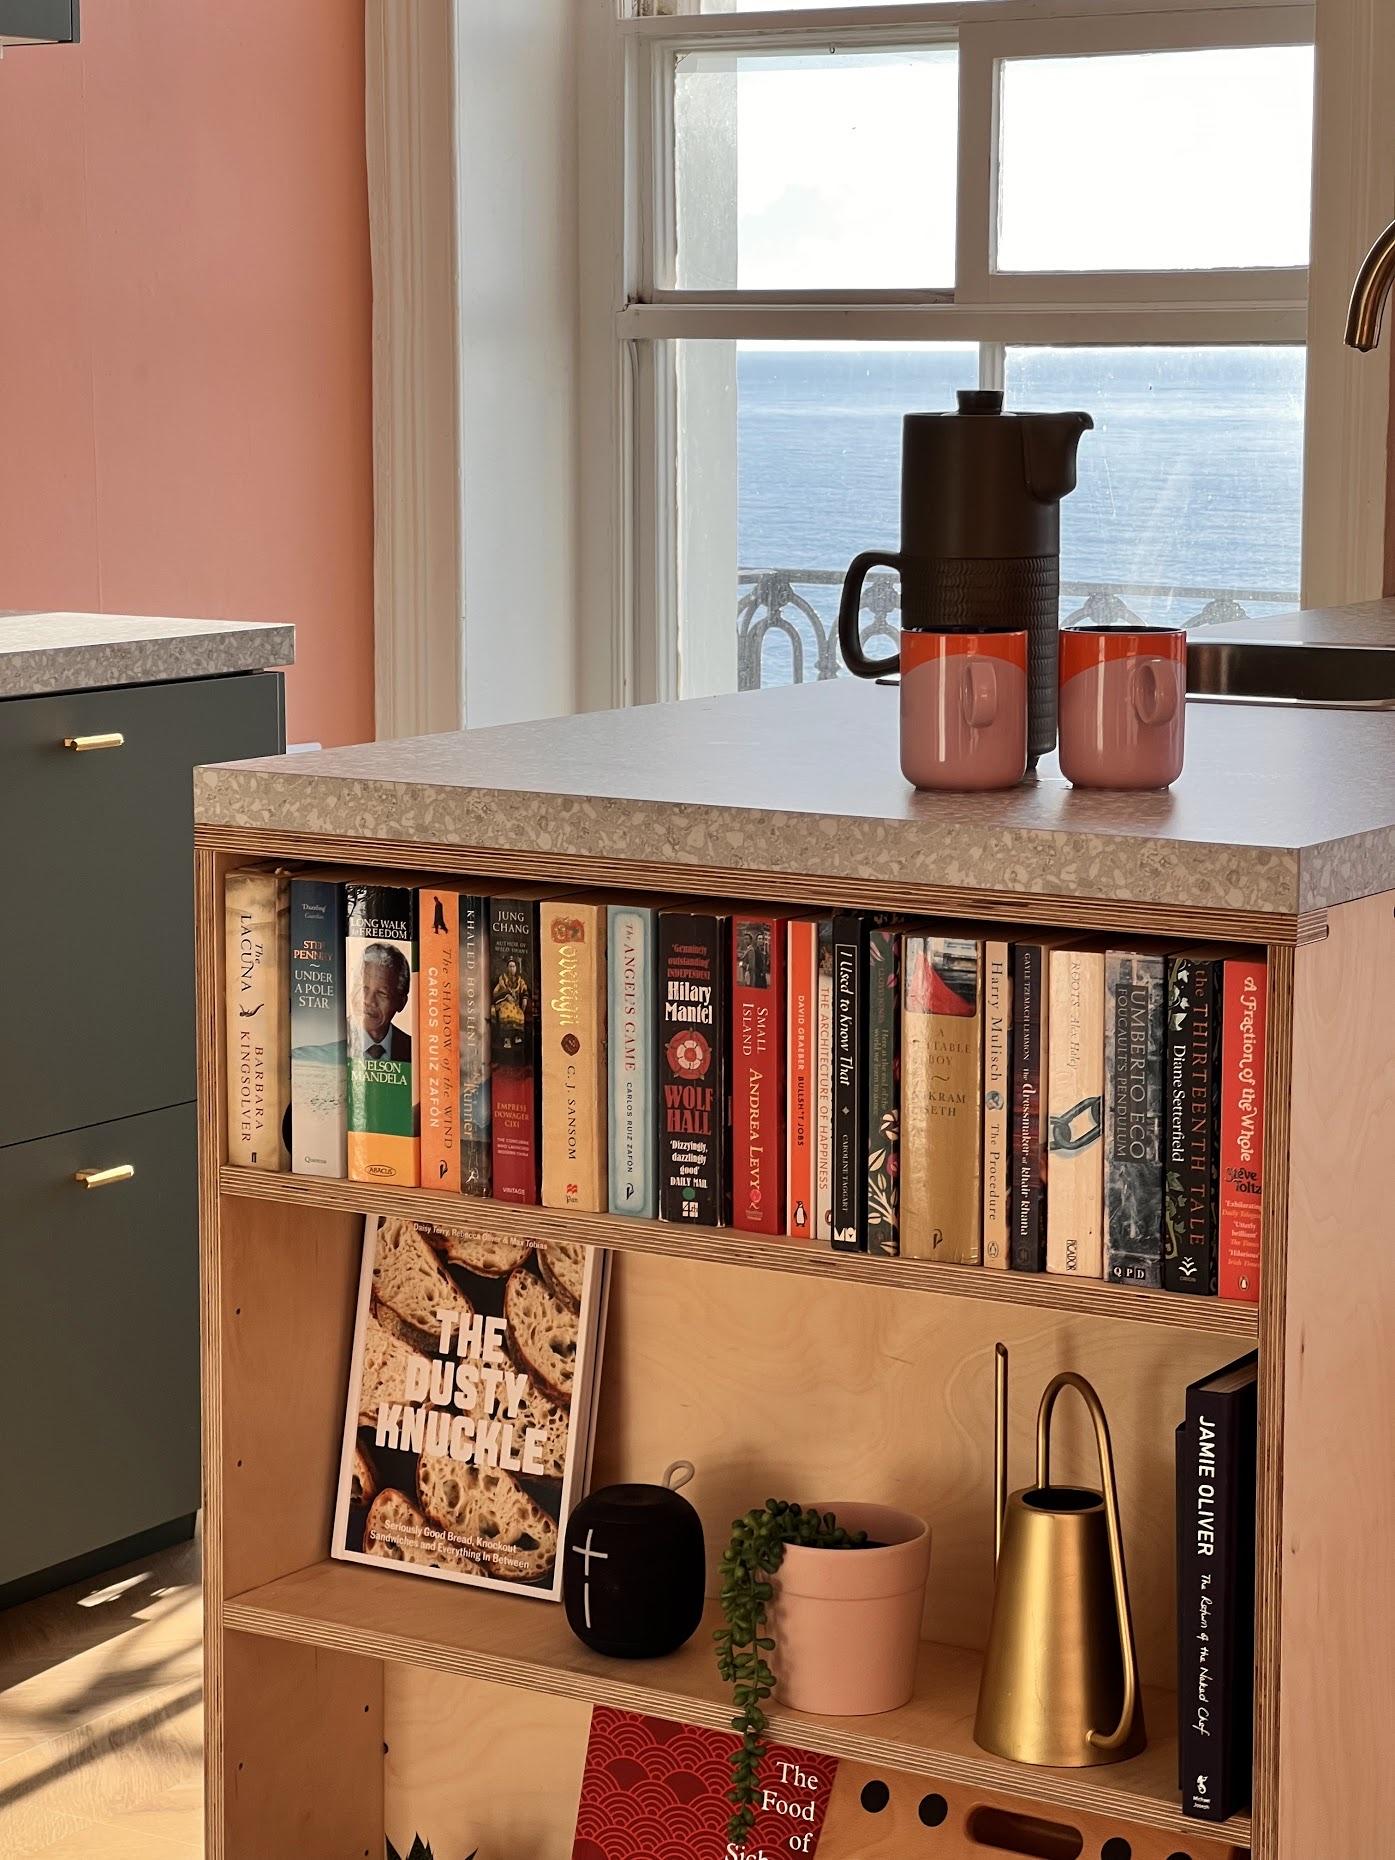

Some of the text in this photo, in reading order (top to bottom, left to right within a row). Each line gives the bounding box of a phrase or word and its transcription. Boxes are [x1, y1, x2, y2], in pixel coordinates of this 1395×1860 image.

[351, 918, 407, 931] LONG WALK
[492, 923, 530, 935] CHANG
[498, 911, 525, 922] JUNG
[359, 928, 408, 940] FREEDOM
[240, 914, 255, 992] LACUNA
[255, 944, 264, 964] The
[293, 949, 334, 961] PENNEY
[1023, 952, 1031, 980] GAYLE
[294, 970, 333, 983] UNDER
[294, 984, 334, 996] A POLE
[466, 910, 476, 1047] KHALED HOSSEINI
[840, 961, 855, 995] Used
[299, 996, 330, 1009] STAR
[623, 923, 636, 1071] The ANGEL'S GAME
[667, 981, 712, 1006] Hilary
[797, 995, 805, 1024] DAVID
[839, 999, 850, 1012] to
[1023, 982, 1031, 1021] TZEMACH
[664, 1002, 713, 1025] Mantel
[742, 1003, 755, 1056] ISLAND
[1067, 961, 1081, 1070] ROOTS Alex Haley
[756, 1007, 769, 1054] SMALL
[839, 1014, 853, 1052] Know
[1023, 1023, 1031, 1061] LEMMON
[428, 967, 441, 1128] CARLOS RUIZ ZAFÓN
[441, 949, 454, 1149] The SHADOW of the WIND
[797, 1028, 805, 1070] GRAEBER
[928, 1055, 953, 1066] BOY
[352, 1070, 408, 1086] MANDELA
[359, 1060, 401, 1074] NELSON
[839, 1056, 854, 1087] That
[1116, 989, 1128, 1157] FOUCAULT'S PENDULUM
[1129, 990, 1146, 1159] UMBERTO ECO
[1237, 976, 1258, 1162] A Fraction of the Whole
[240, 1031, 251, 1142] KINGSOLVER
[255, 1047, 264, 1130] BARBARA
[664, 1085, 714, 1111] WOLF
[819, 987, 830, 1190] THE ARCHITECTURE OF HAPPINESS
[988, 962, 1003, 1221] Harry Mulisch The Procedure
[463, 1083, 479, 1138] Runner
[494, 1111, 530, 1121] DOWAGER
[497, 1102, 527, 1112] EMPRESS
[565, 1065, 577, 1160] C. J. SANSOM
[749, 1067, 764, 1141] ANDREA
[924, 1105, 956, 1117] SETH
[1022, 1083, 1037, 1155] dressmaker
[1171, 1045, 1186, 1162] Diane Setterfield
[1189, 970, 1209, 1246] the THIRTEENTH TALE
[504, 1120, 520, 1129] CIXI
[666, 1109, 712, 1136] HALL
[797, 1124, 805, 1146] JOBS
[368, 1167, 393, 1175] ABACUS
[626, 1144, 634, 1173] ZAFÓN
[671, 1153, 707, 1165] dazzlingly
[749, 1145, 764, 1192] LEVY
[841, 1134, 850, 1212] CAROLINE TAGGART
[1224, 1167, 1257, 1183] Steve
[502, 1187, 526, 1196] VINTAGE
[670, 1176, 709, 1189] DAILY MAIL
[1021, 1166, 1031, 1197] khair
[1231, 1180, 1262, 1195] Toltz
[1020, 1200, 1031, 1236] khana
[413, 1223, 432, 1235] Daisy
[451, 1230, 481, 1241] Rebecca
[482, 1233, 502, 1243] Oliver
[509, 1238, 525, 1246] Max
[524, 1240, 548, 1250] Tobias
[1066, 1239, 1078, 1271] PICADOR
[435, 1309, 508, 1364] THE
[403, 1358, 529, 1419] DUSTY
[374, 1402, 548, 1476] KNUCKLE
[1197, 1415, 1216, 1556] JAMIE OLIVER
[369, 1530, 530, 1569] Sandwiches and Everything In Between
[384, 1519, 517, 1554] Seriously Good Bread, Knockout
[1191, 1573, 1213, 1737] The Return of the Naked Chef
[775, 1761, 819, 1791] The
[760, 1789, 816, 1823] Food
[788, 1832, 814, 1853] of
